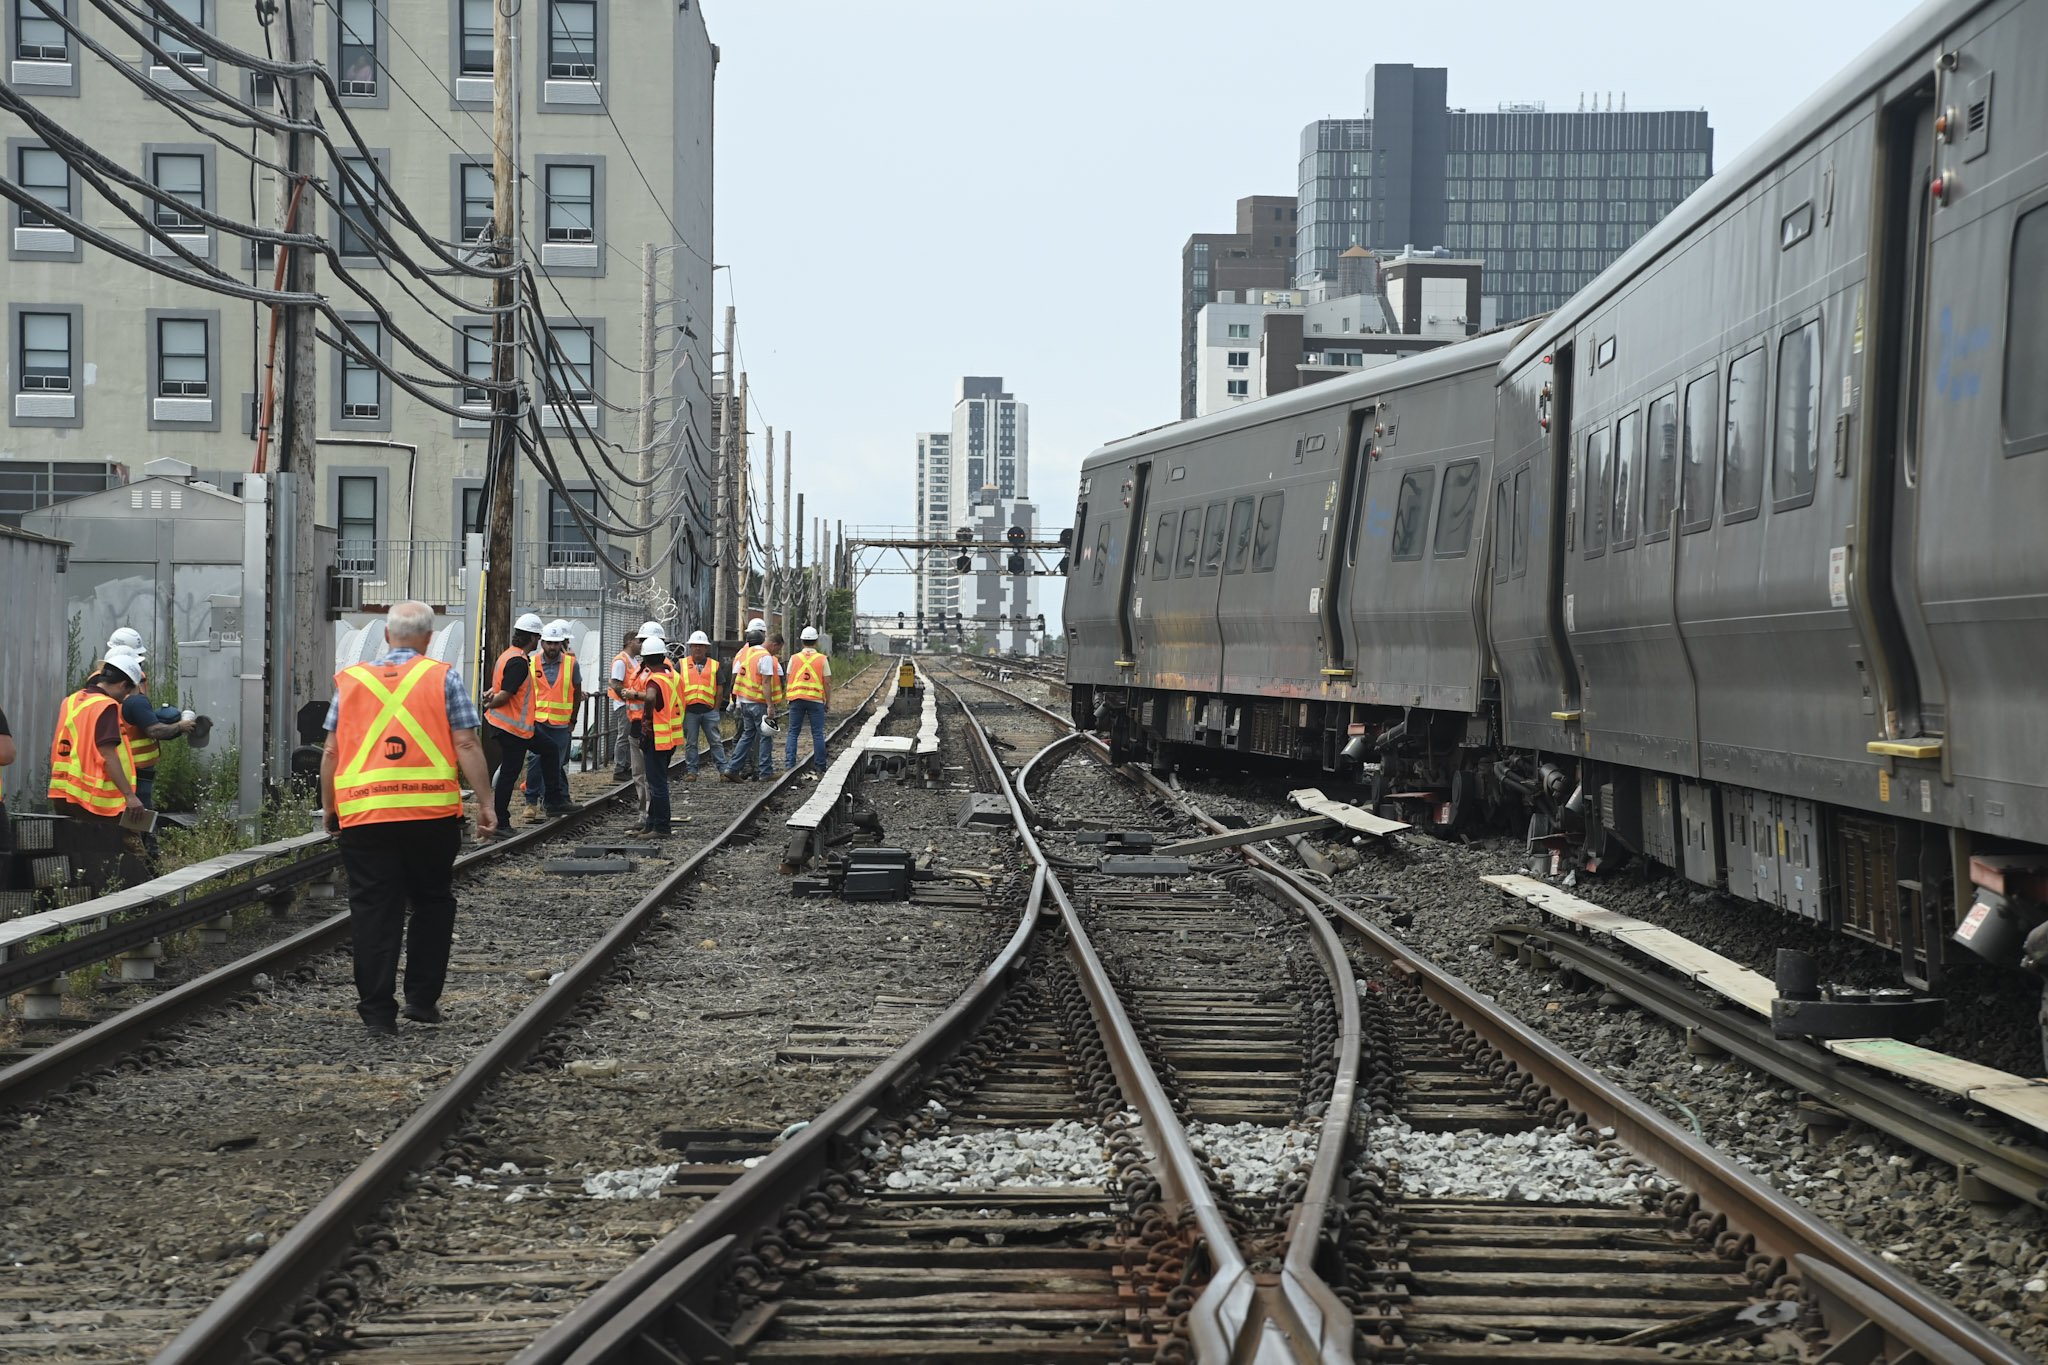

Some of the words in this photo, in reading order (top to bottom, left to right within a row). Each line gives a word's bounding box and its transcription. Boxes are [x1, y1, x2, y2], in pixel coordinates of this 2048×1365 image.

[384, 740, 404, 757] MTA
[348, 787, 370, 798] Long
[371, 783, 399, 793] Island
[401, 783, 419, 791] Rail
[421, 783, 445, 791] Road
